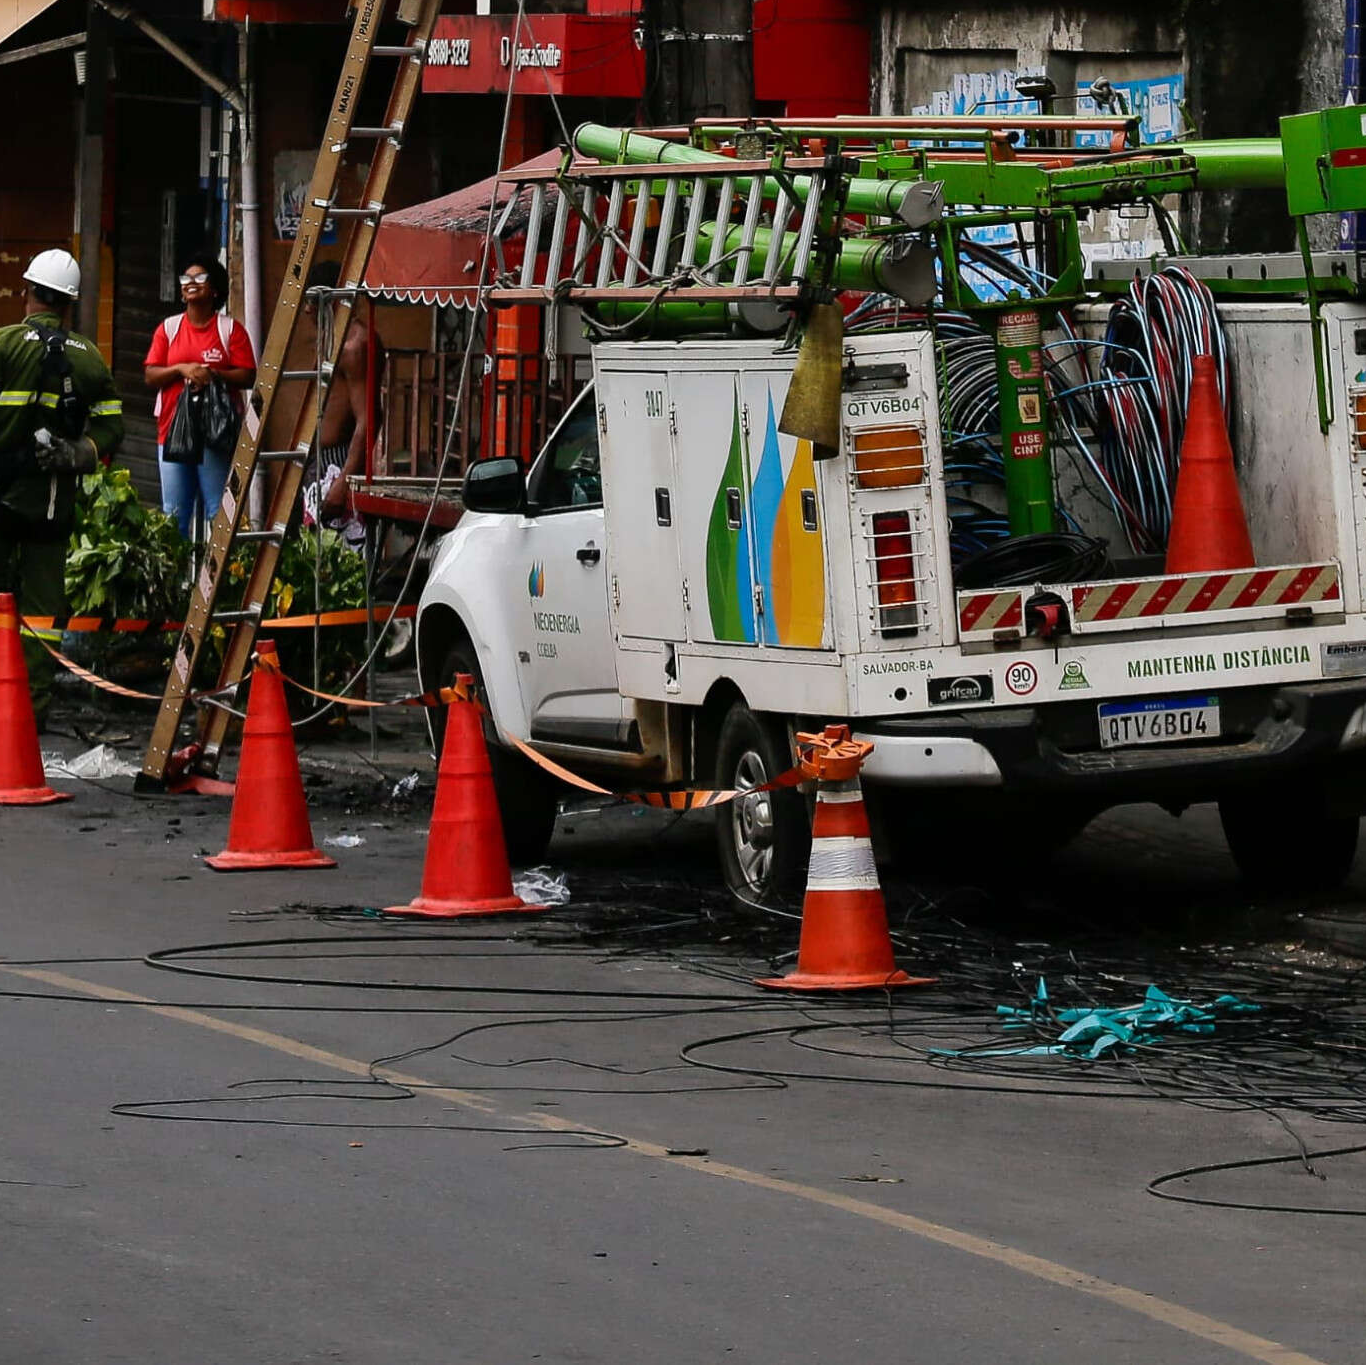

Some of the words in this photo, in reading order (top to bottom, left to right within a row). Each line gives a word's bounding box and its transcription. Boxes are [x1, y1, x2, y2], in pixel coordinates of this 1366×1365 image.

[338, 75, 355, 113] MAR/21
[1019, 434, 1041, 444] USE
[534, 612, 581, 634] NEOENERGIA
[863, 660, 934, 676] SALVADOR-BA
[1128, 653, 1216, 679] MANTENHA
[1223, 645, 1311, 671] DISTÂNCIA
[1011, 667, 1031, 683] 90
[939, 685, 980, 701] grifcar
[1109, 710, 1208, 741] QTV6B04
